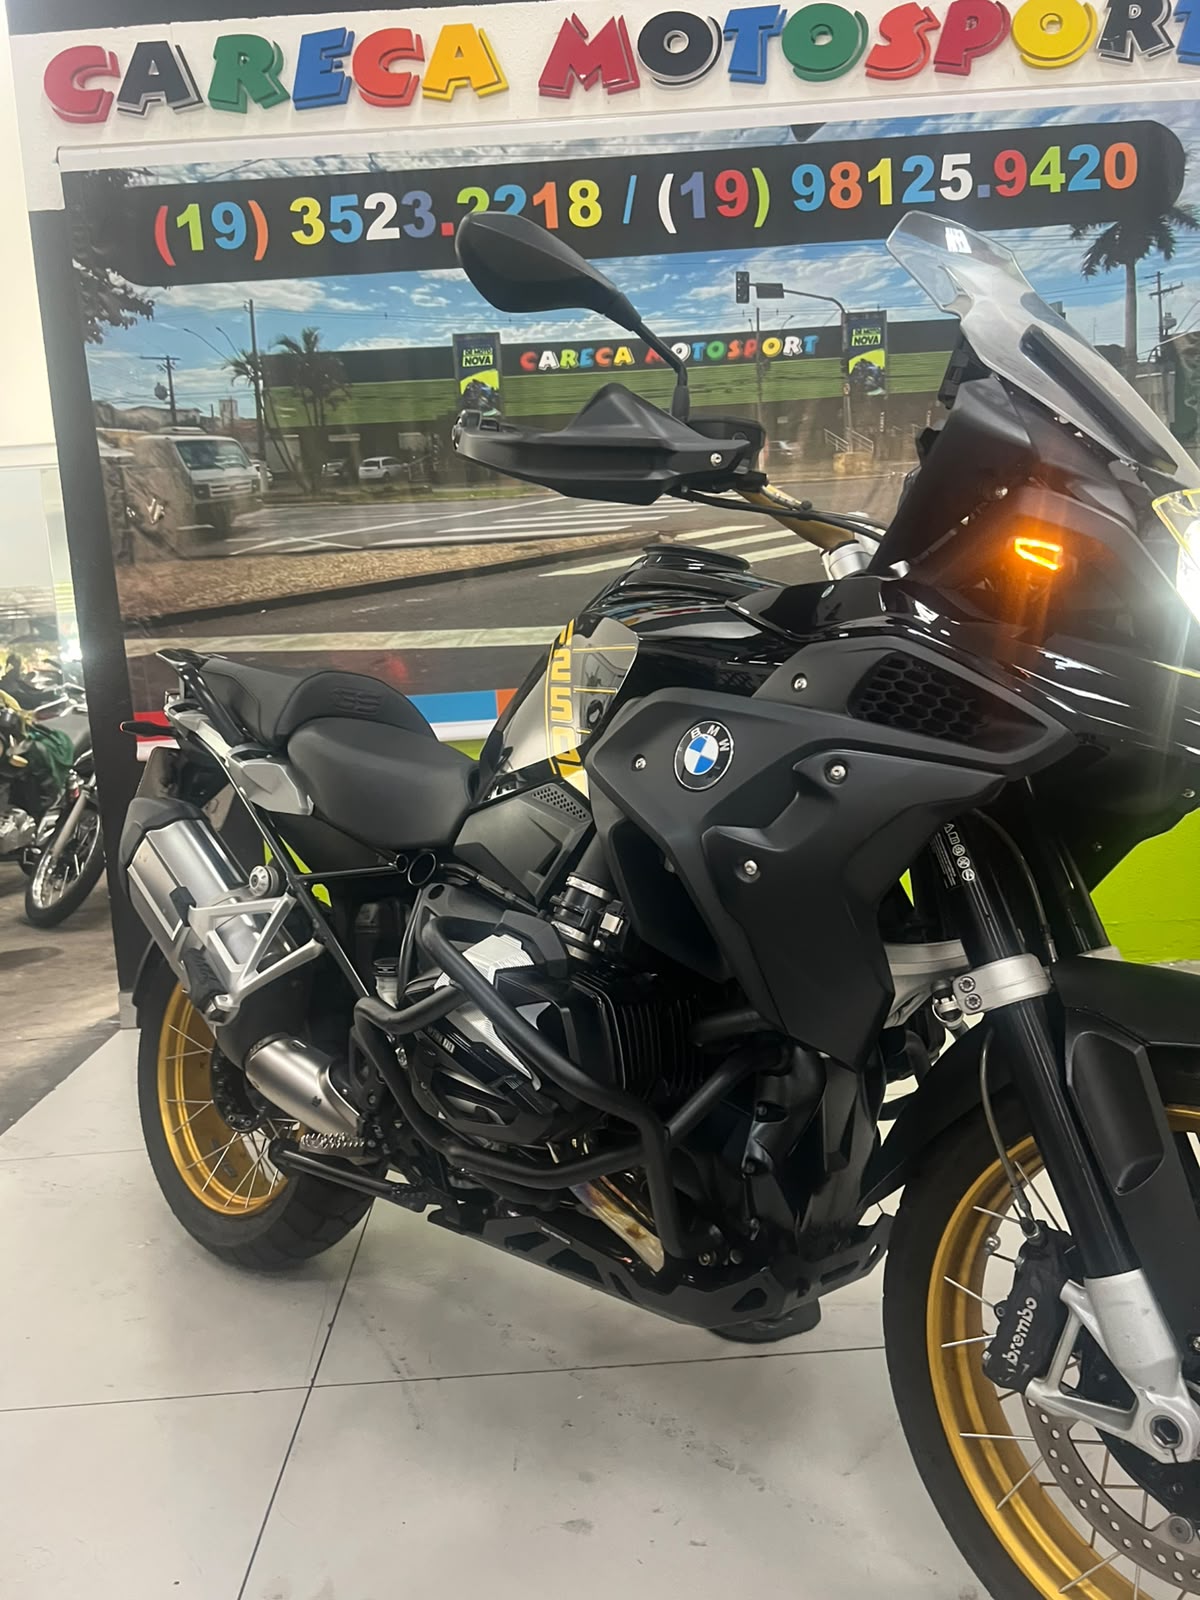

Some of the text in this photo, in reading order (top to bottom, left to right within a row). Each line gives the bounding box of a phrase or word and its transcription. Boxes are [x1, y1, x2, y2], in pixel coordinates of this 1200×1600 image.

[43, 23, 509, 123] CARECA
[154, 200, 268, 267] (19)
[289, 179, 602, 244] 3523.2218
[658, 168, 770, 234] (19)
[792, 142, 1138, 212] 98125.9420
[854, 335, 879, 345] NOVA
[465, 355, 491, 366] NOVA
[520, 346, 635, 371] CARECA
[690, 725, 730, 752] BMW
[1002, 1297, 1038, 1366] brembo
